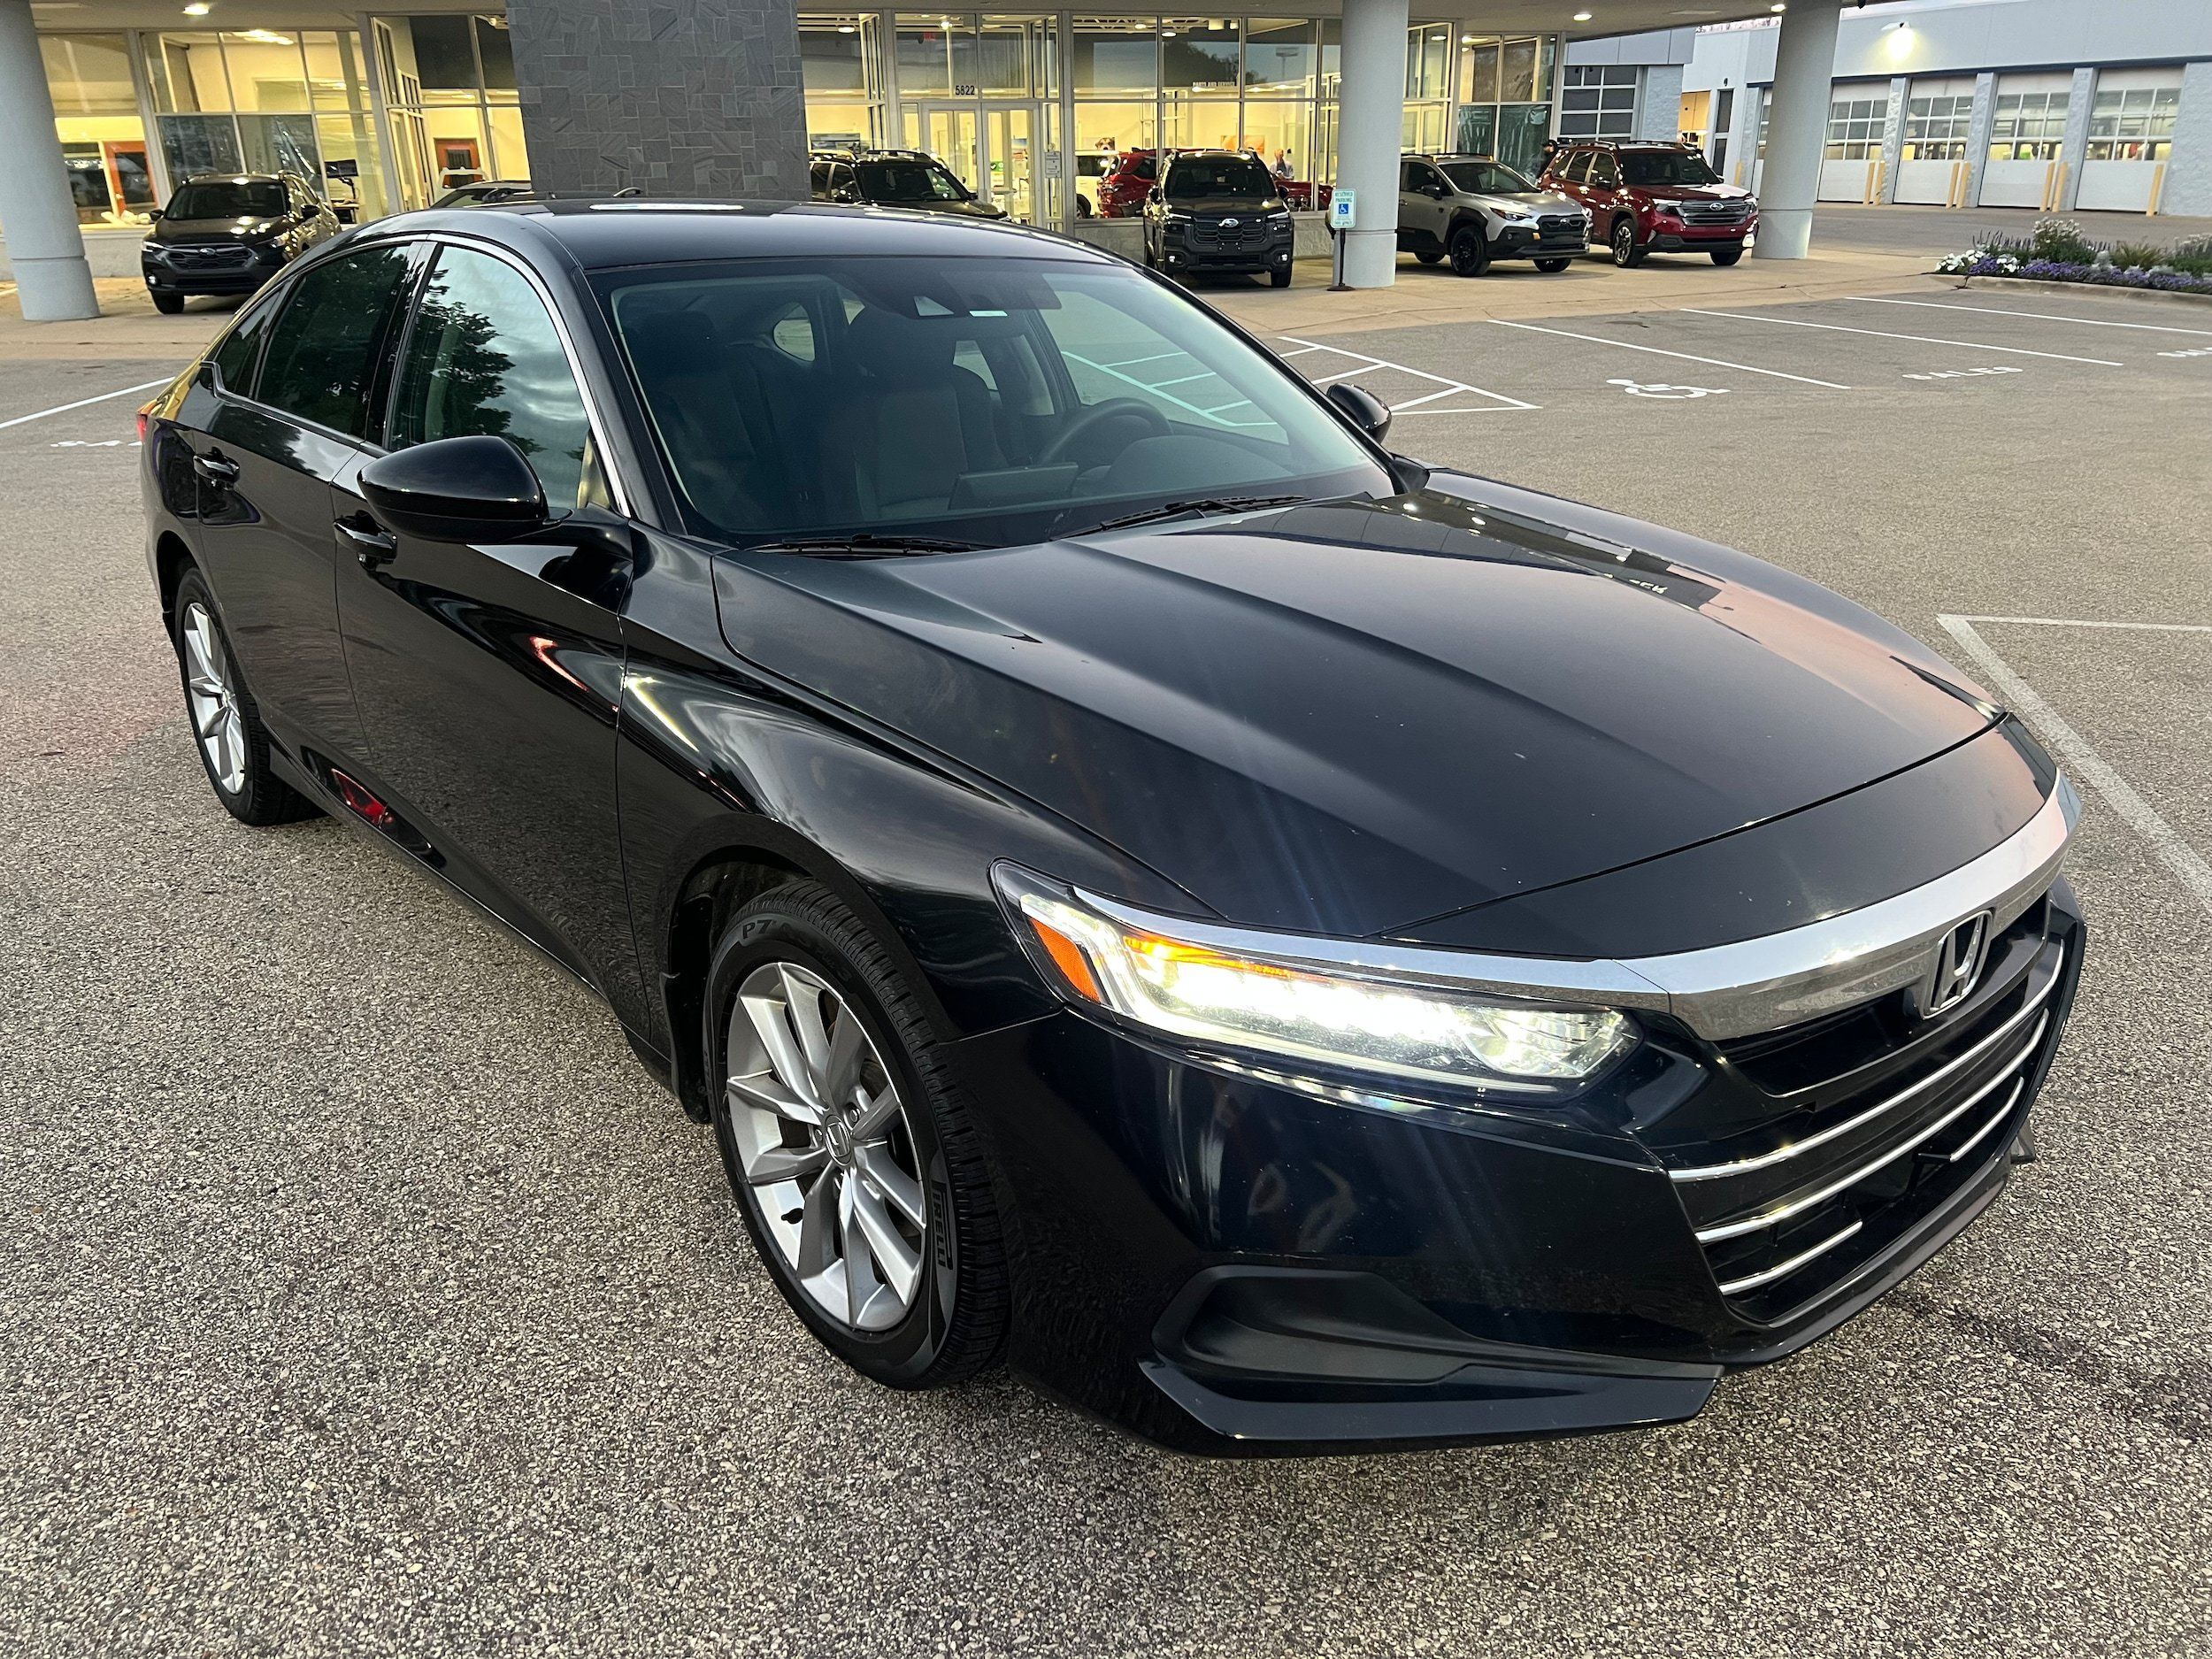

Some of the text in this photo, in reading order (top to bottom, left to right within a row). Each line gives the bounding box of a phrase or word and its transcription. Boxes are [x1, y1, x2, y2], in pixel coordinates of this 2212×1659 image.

[955, 85, 975, 96] 5822
[1901, 365, 2024, 380] SALES
[742, 918, 772, 940] P7
[932, 1179, 954, 1271] PIRELLI
